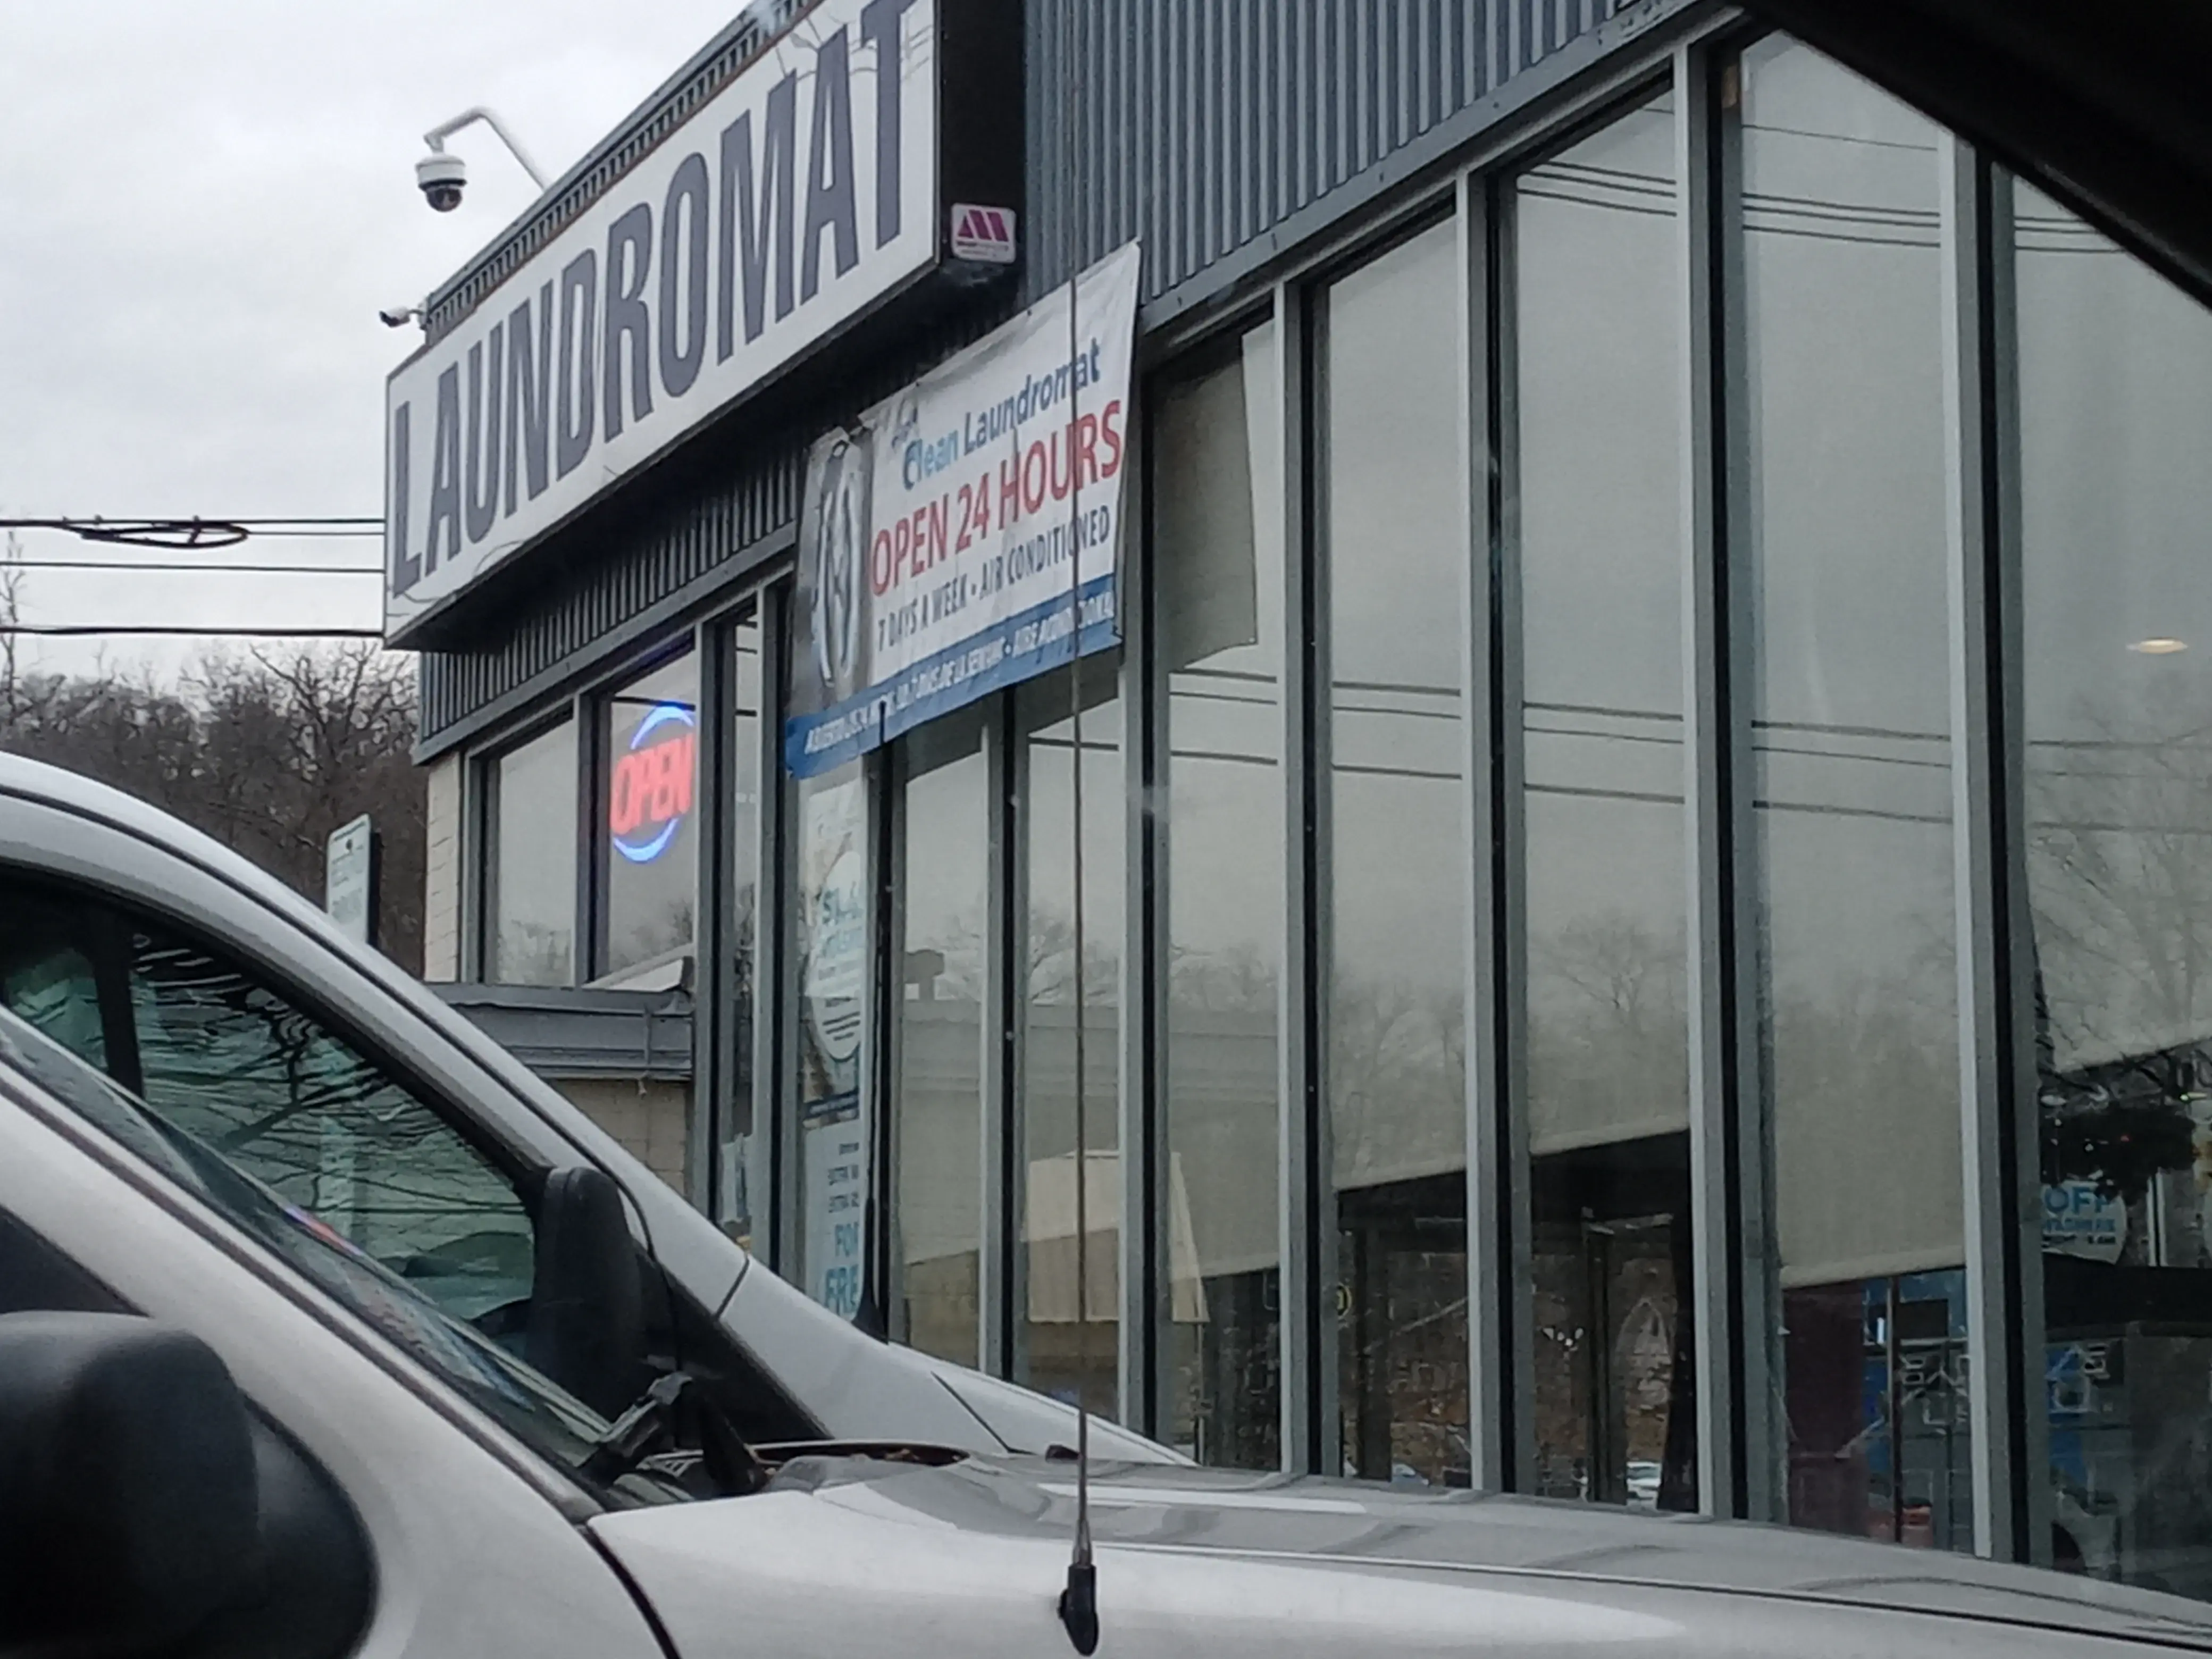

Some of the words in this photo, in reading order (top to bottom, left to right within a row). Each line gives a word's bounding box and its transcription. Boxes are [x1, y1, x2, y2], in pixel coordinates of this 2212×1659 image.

[392, 0, 918, 598] LAUNDROMAT
[903, 428, 958, 490] Clean
[963, 337, 1101, 456] Laundromat
[872, 492, 949, 597] OPEN
[955, 472, 990, 555] 24
[998, 399, 1120, 531] HOURS
[888, 598, 918, 647] DAYS
[931, 573, 967, 623] WEEK
[979, 556, 1003, 600] AIR
[1007, 505, 1110, 584] CONDITIONED
[610, 733, 694, 834] OPEN
